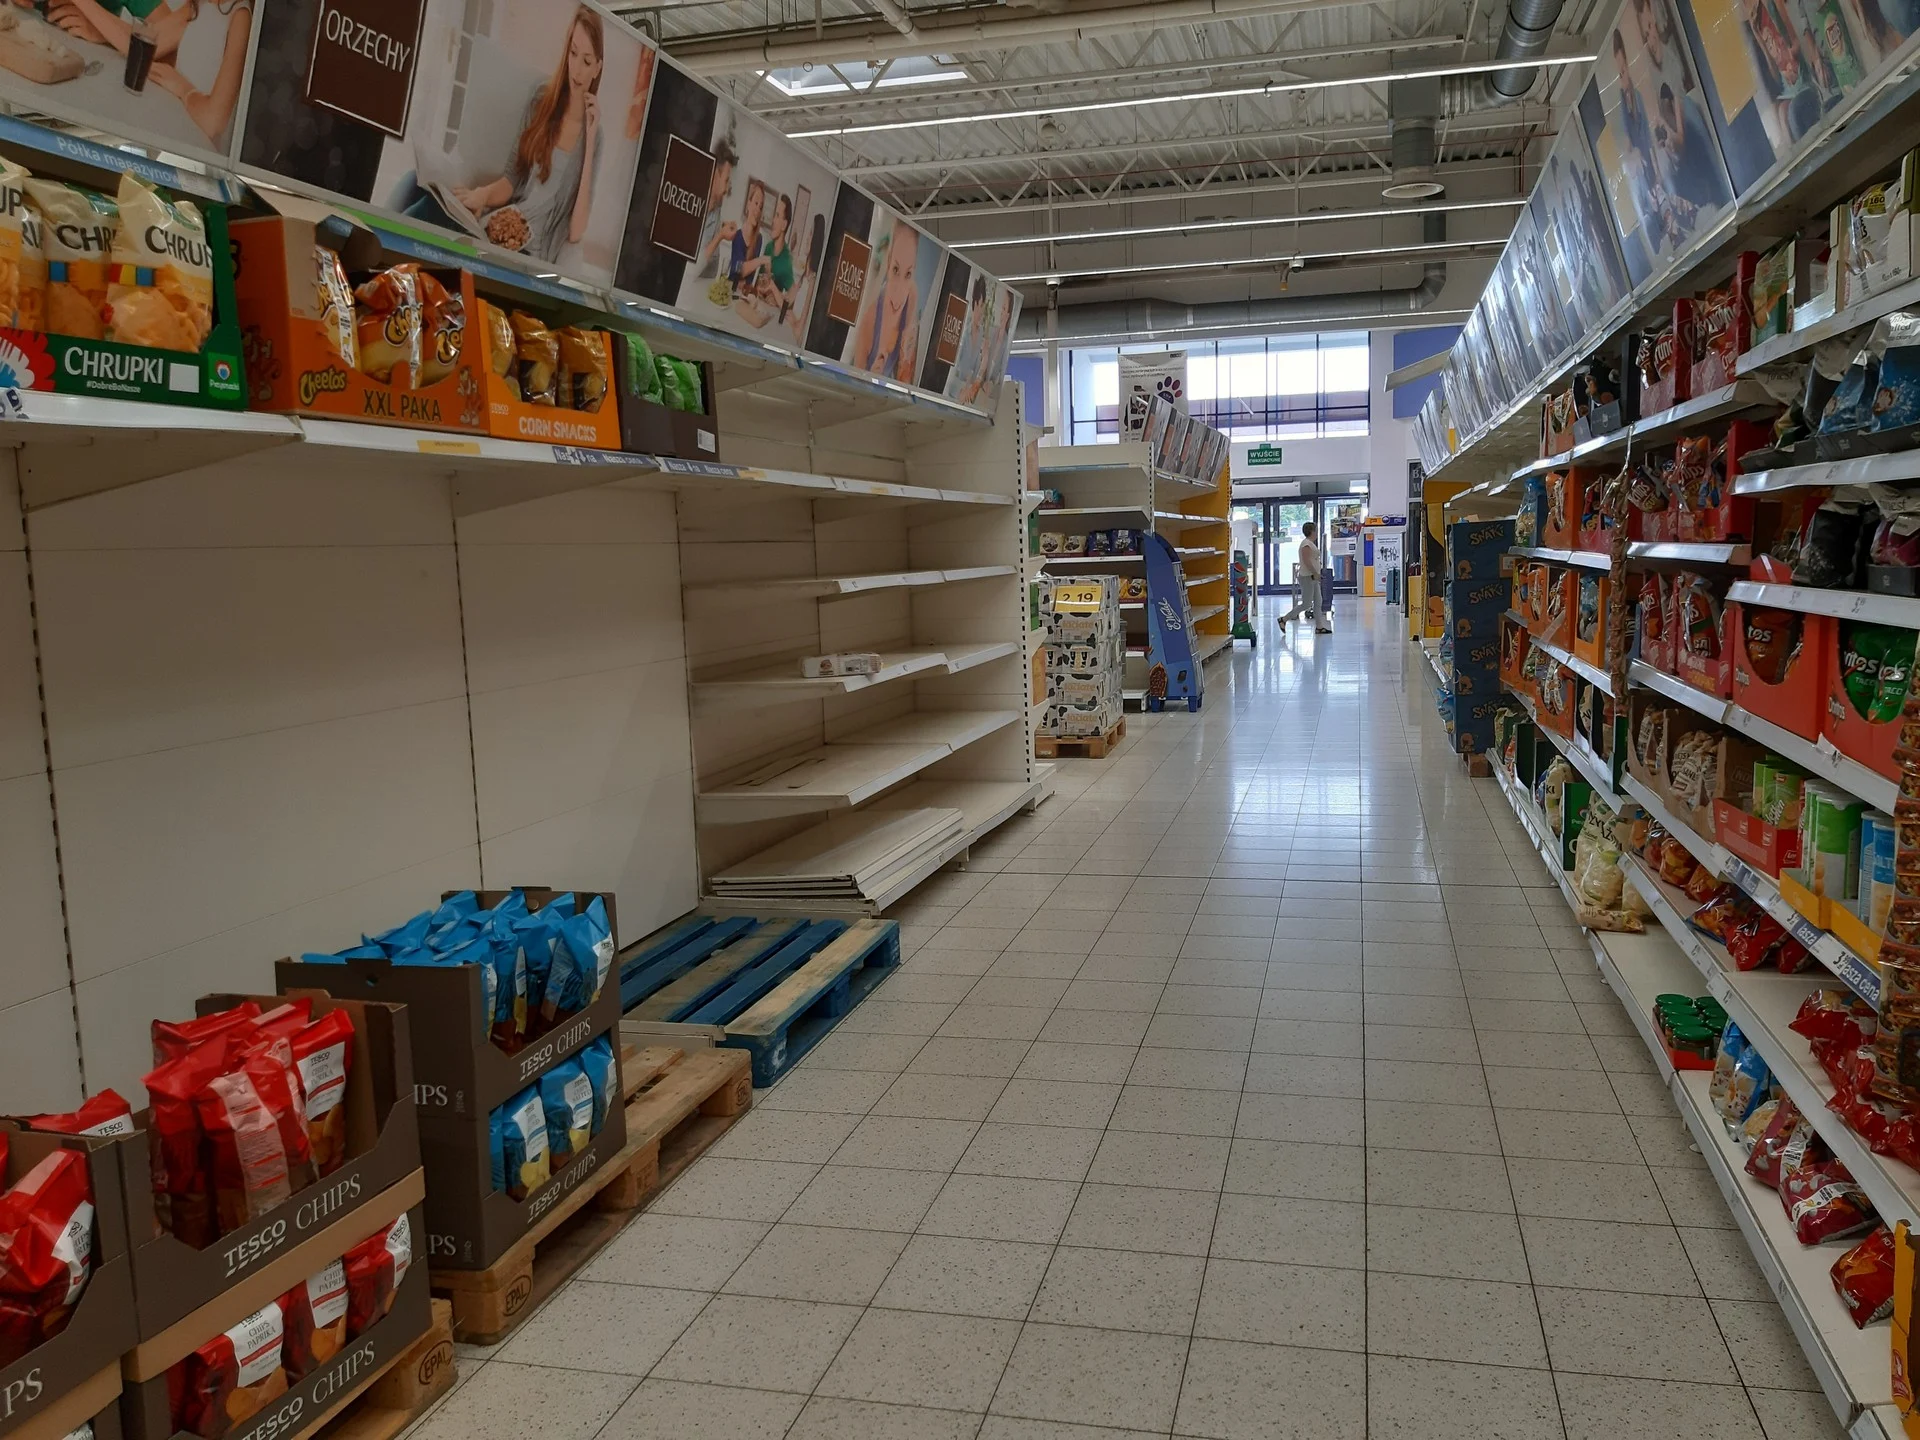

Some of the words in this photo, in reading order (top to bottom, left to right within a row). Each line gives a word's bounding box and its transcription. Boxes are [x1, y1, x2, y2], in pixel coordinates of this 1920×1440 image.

[325, 9, 411, 73] ORZECHY
[662, 181, 705, 218] ORZECHY
[839, 260, 864, 288] SŁONE
[64, 346, 163, 384] CHRUPKI
[301, 369, 347, 406] Cheetos
[364, 389, 396, 417] XXL
[400, 394, 442, 422] PAKA
[519, 416, 550, 436] CORN
[553, 421, 597, 443] SNACKS
[1250, 450, 1280, 458] WYJŚCIE
[1860, 977, 1880, 1002] cena
[519, 1044, 553, 1075] TESCO
[557, 1016, 592, 1055] CHIPS
[98, 1121, 124, 1135] TESCO
[528, 1181, 561, 1219] TESCO
[564, 1148, 598, 1191] CHIPS
[224, 1220, 288, 1268] TESCO
[295, 1174, 362, 1231] CHIPS
[506, 1283, 528, 1312] EPAL
[313, 1341, 376, 1404] CHIPS
[424, 1347, 450, 1381] EPAL
